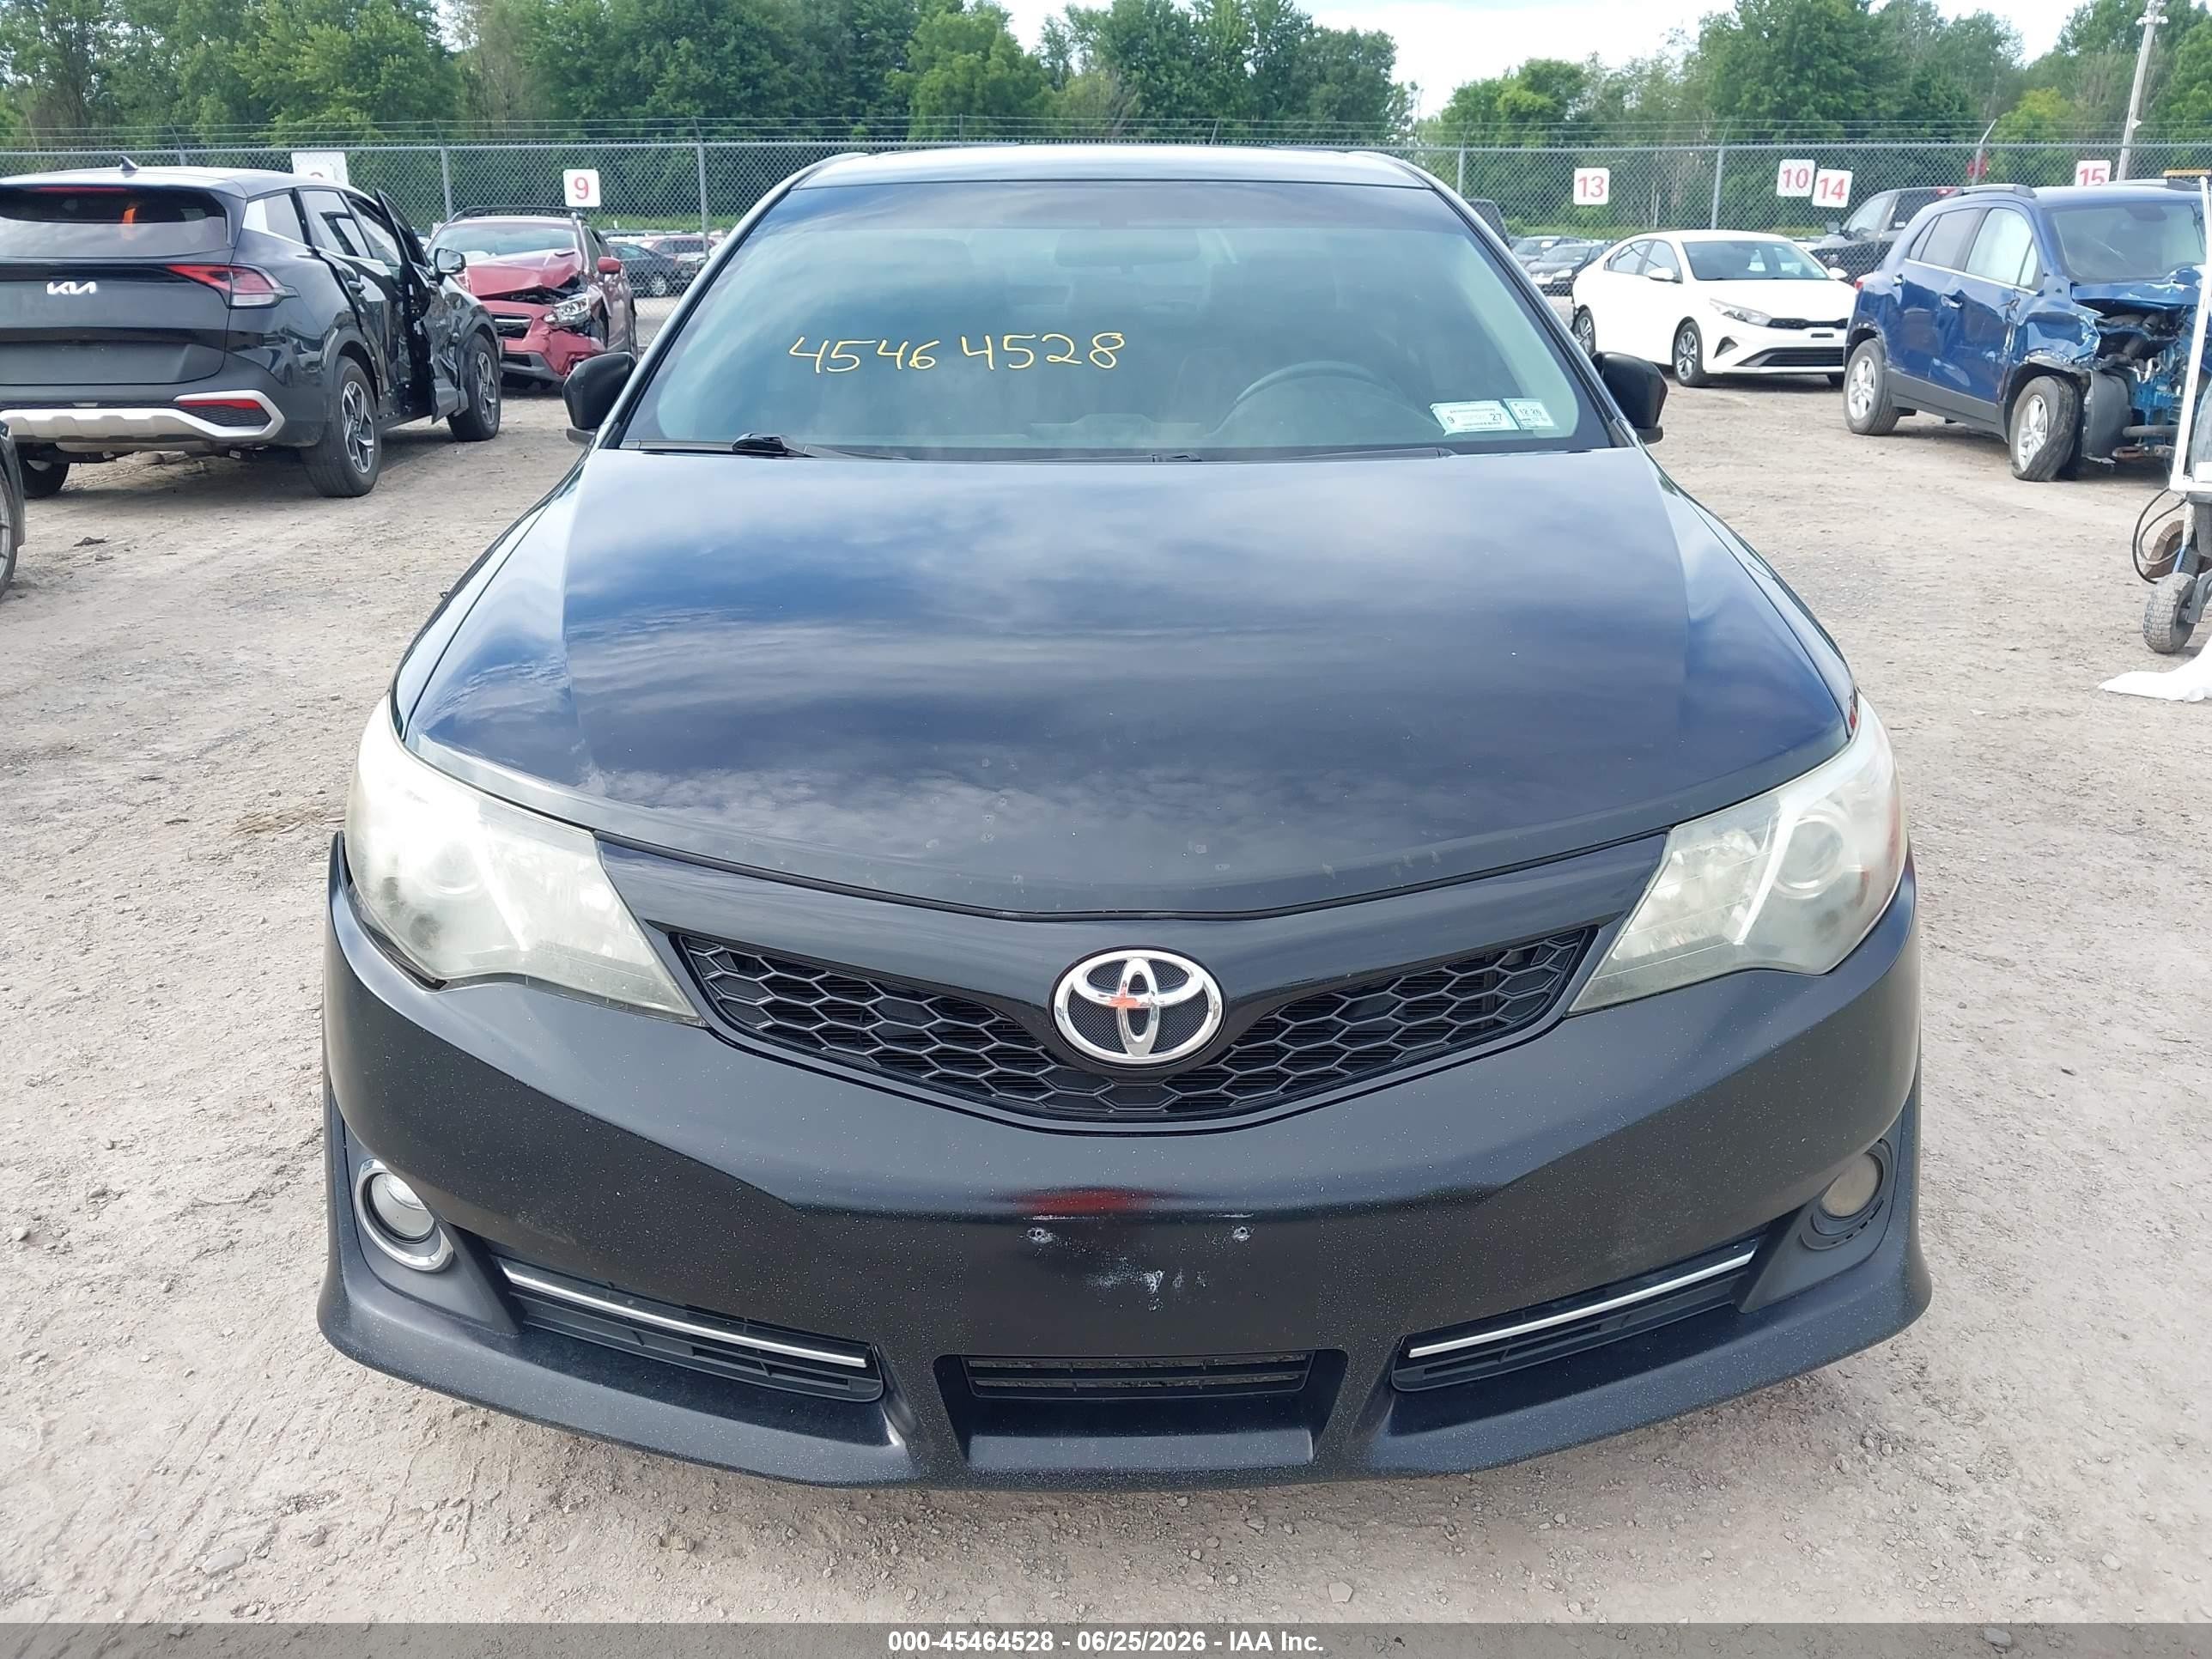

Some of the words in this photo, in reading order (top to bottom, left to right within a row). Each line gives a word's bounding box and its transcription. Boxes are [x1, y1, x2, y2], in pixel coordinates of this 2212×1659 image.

[574, 176, 589, 200] 9
[1578, 175, 1604, 198] 13
[1783, 167, 1809, 189] 10
[2080, 167, 2106, 186] 15
[1819, 176, 1845, 201] 14
[46, 281, 96, 295] KIA
[788, 335, 942, 374] 4546
[961, 331, 1127, 371] 4528
